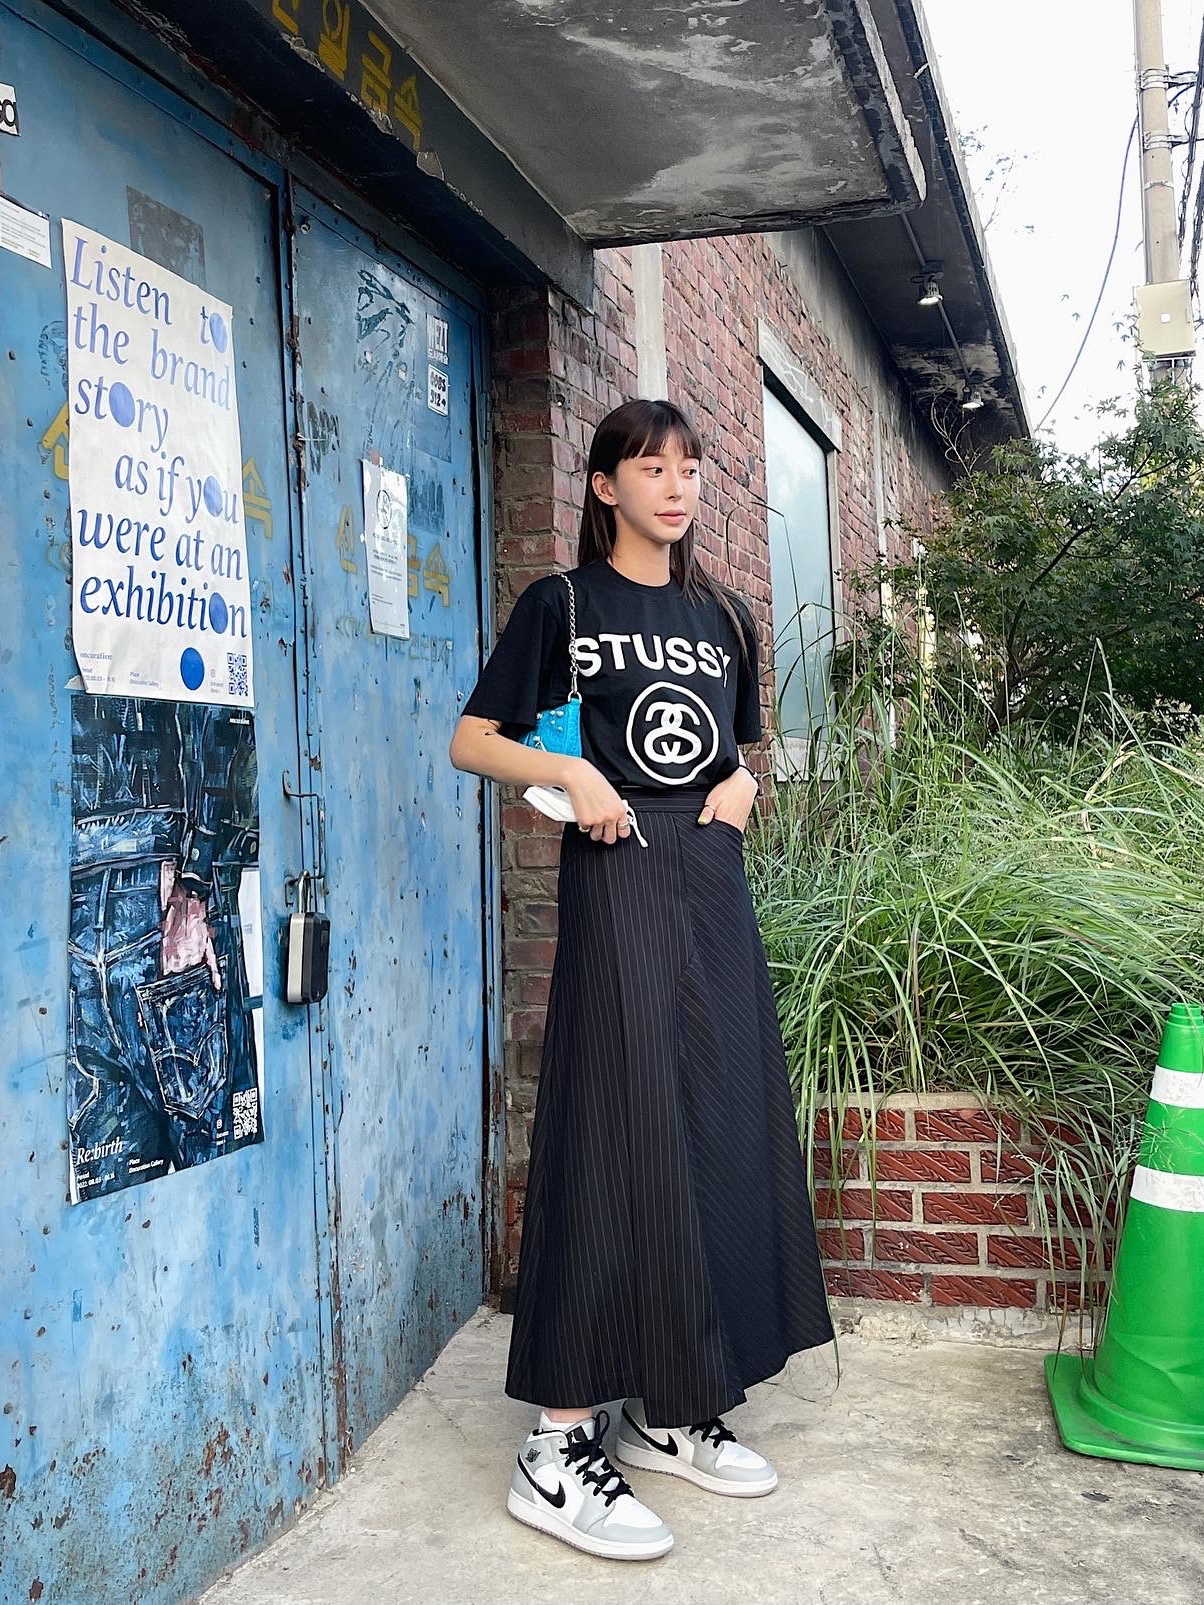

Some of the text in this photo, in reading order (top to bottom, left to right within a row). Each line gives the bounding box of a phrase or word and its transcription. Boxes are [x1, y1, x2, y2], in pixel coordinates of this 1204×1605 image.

[71, 236, 172, 326] Listen
[74, 302, 130, 365] the
[151, 328, 231, 411] brand
[74, 376, 169, 454] story
[115, 454, 148, 496] as
[157, 451, 185, 517] if
[77, 509, 243, 581] were at an
[79, 565, 247, 639] exhibition
[75, 1136, 123, 1166] Re:birth
